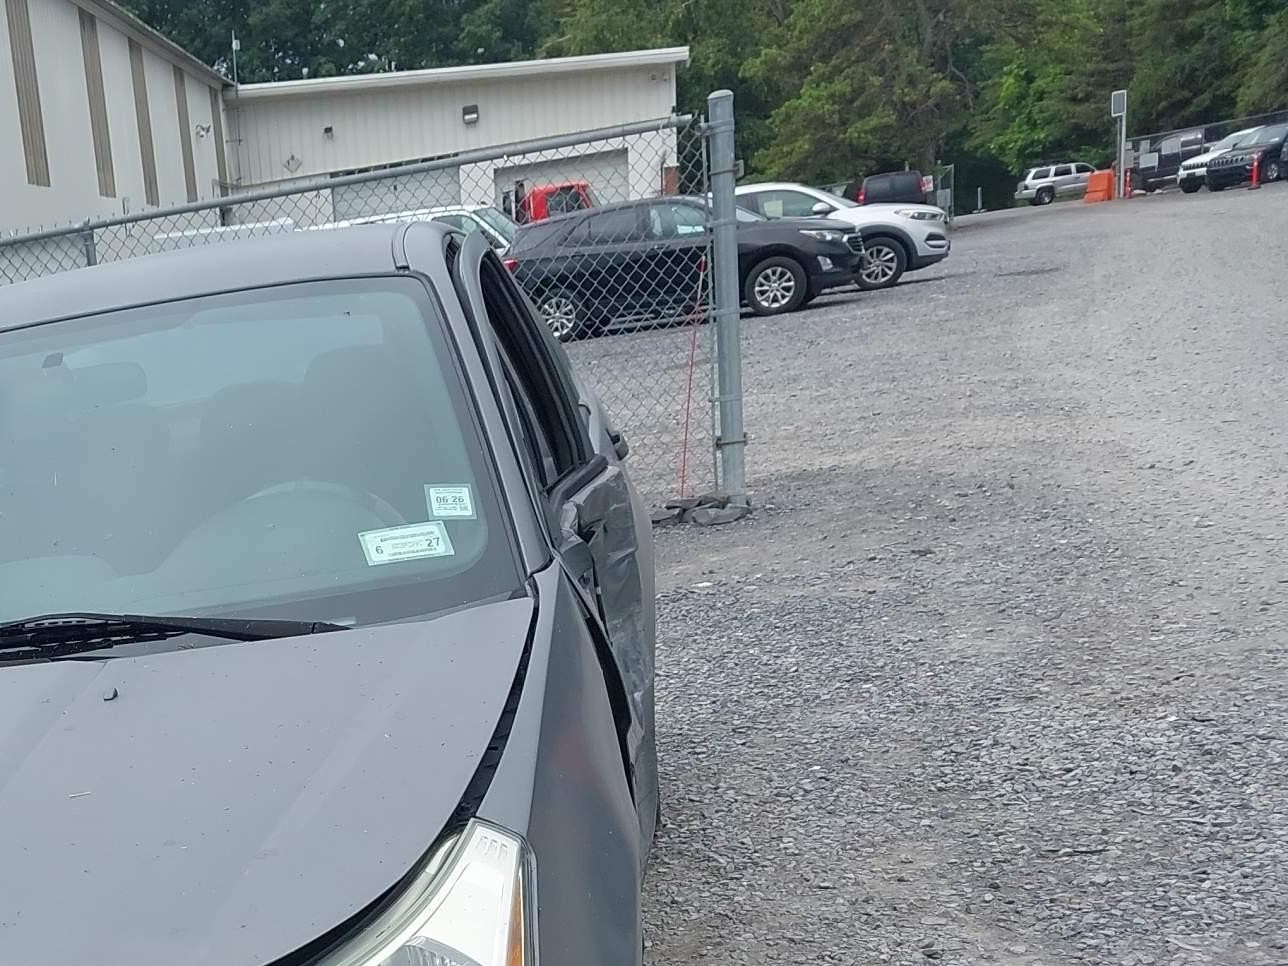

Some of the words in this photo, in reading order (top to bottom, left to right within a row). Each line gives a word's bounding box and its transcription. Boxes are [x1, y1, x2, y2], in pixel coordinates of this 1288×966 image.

[435, 495, 449, 504] 06
[451, 495, 465, 503] 26
[375, 545, 384, 555] 6
[424, 536, 441, 548] 27
